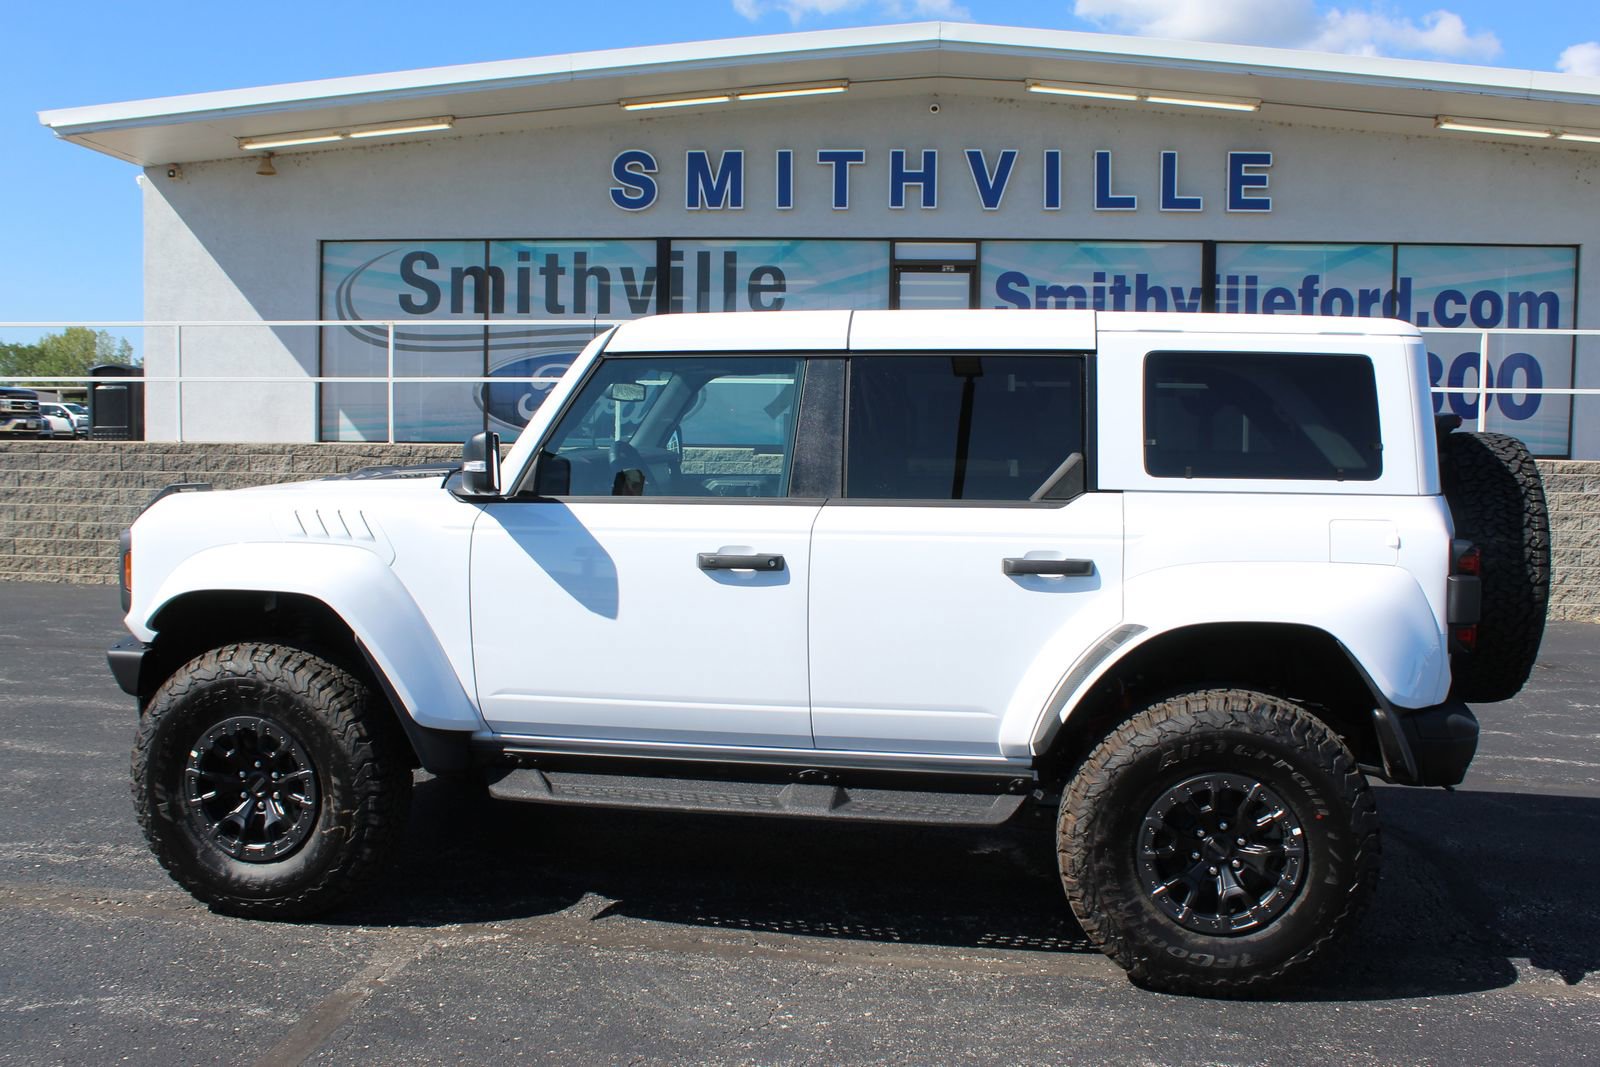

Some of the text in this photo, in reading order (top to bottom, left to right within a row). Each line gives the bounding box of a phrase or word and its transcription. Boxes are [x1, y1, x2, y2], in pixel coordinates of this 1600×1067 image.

[609, 149, 1273, 212] SMITHVILLE
[397, 250, 787, 315] Smithville
[995, 271, 1561, 329] Smithvlleford.com
